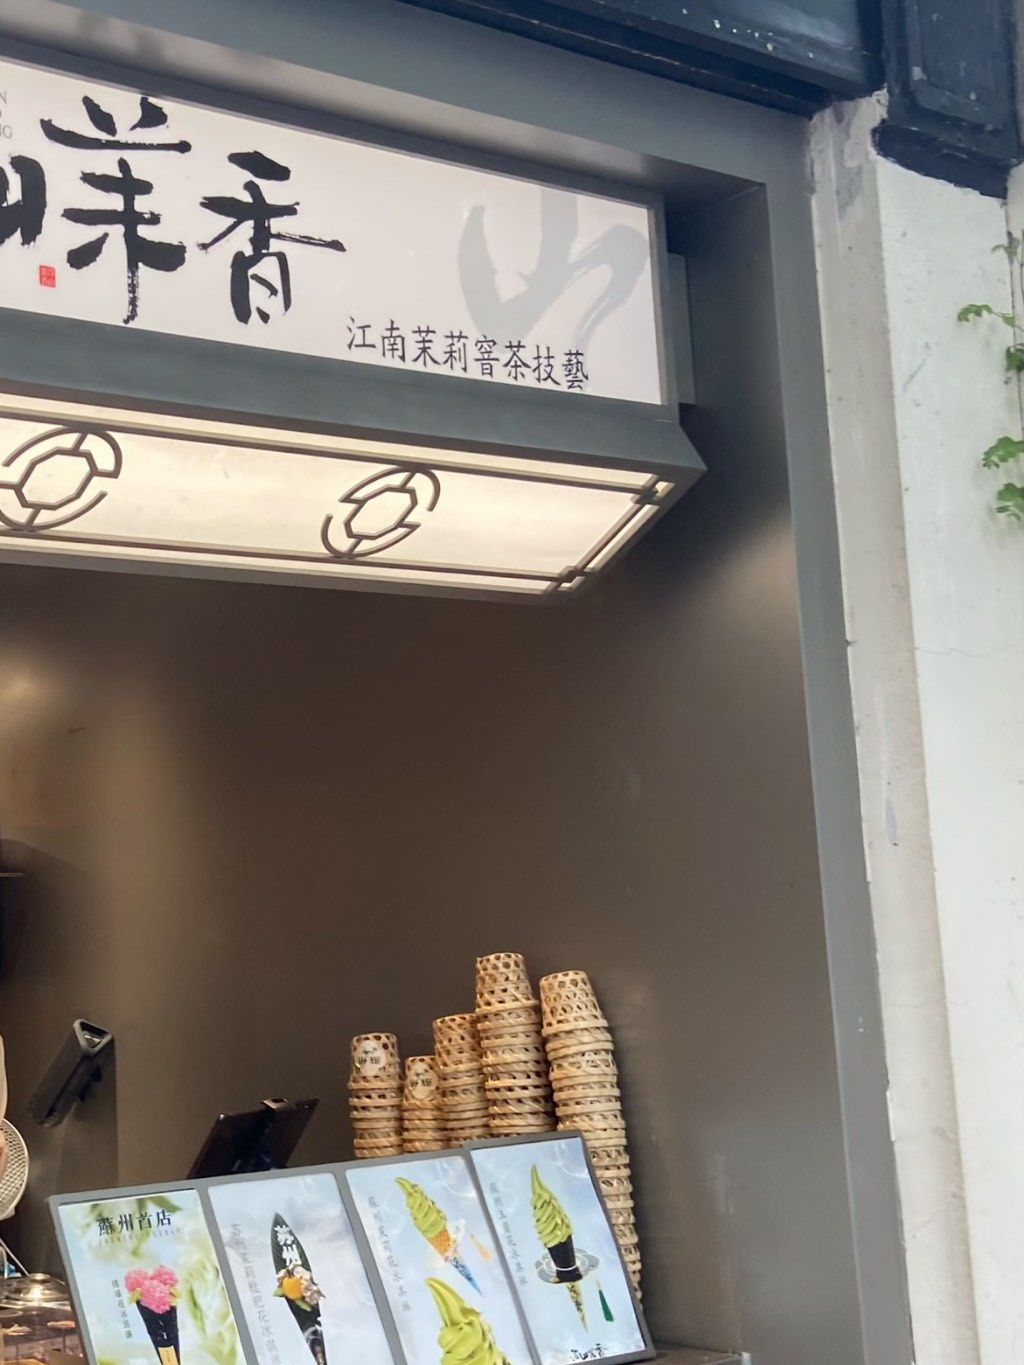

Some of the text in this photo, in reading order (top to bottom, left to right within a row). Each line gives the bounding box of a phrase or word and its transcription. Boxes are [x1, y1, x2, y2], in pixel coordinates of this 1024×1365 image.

[346, 316, 589, 390] 江南茉莉窨茶技藝
